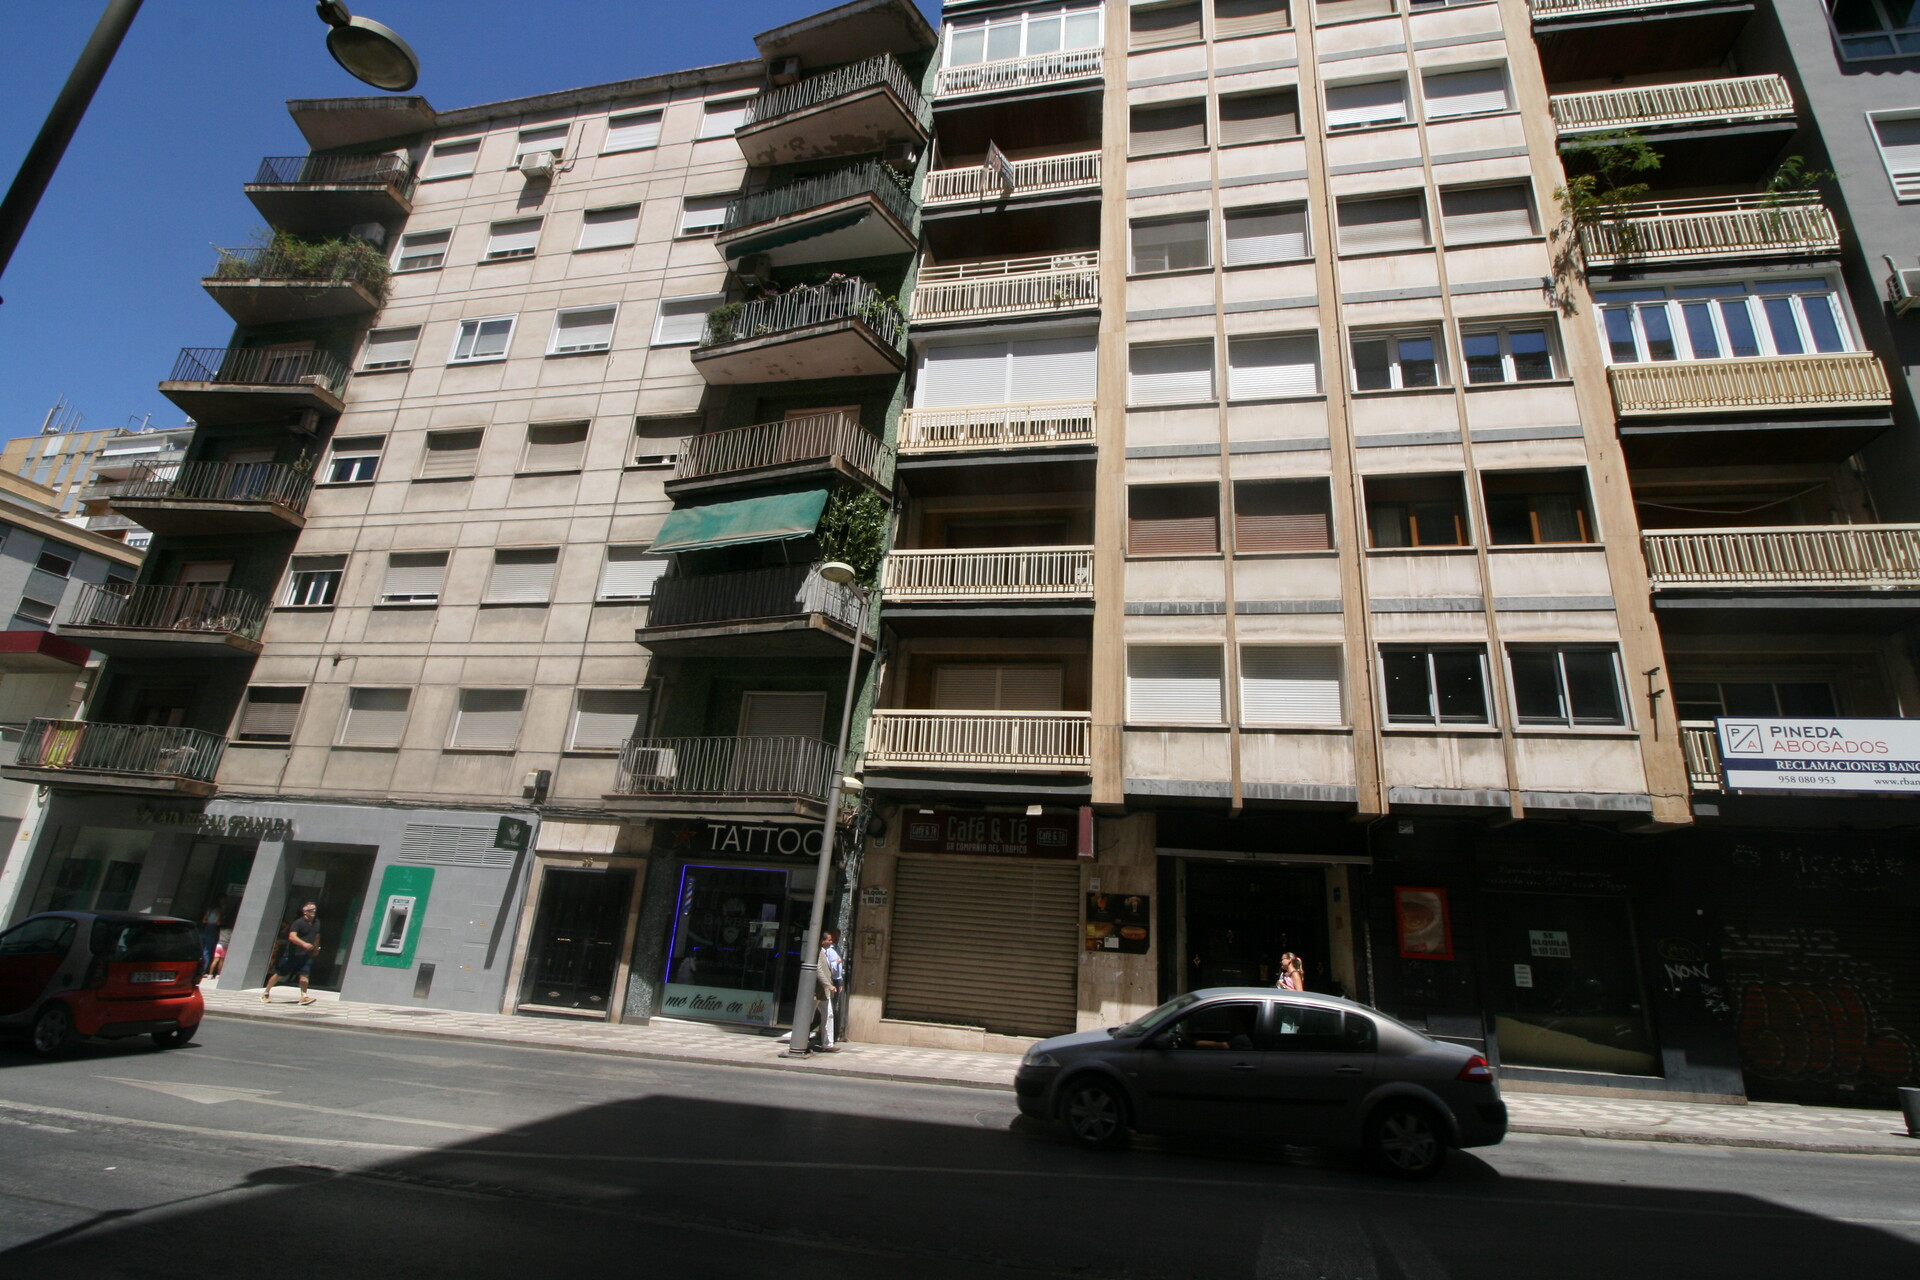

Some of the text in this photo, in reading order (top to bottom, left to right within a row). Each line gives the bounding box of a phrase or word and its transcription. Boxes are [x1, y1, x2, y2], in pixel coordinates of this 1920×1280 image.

[1770, 726, 1843, 738] PINEDA
[1773, 740, 1889, 754] ABOGADOS
[1776, 760, 1886, 771] RECLAMACIONES
[1778, 775, 1796, 784] 958
[1798, 775, 1816, 784] 080
[1817, 776, 1836, 784] 953
[947, 815, 1028, 844] Café & Té
[707, 823, 824, 856] TATTOO
[1532, 938, 1567, 947] ALQUILA
[665, 995, 688, 1008] me
[726, 1001, 743, 1013] en
